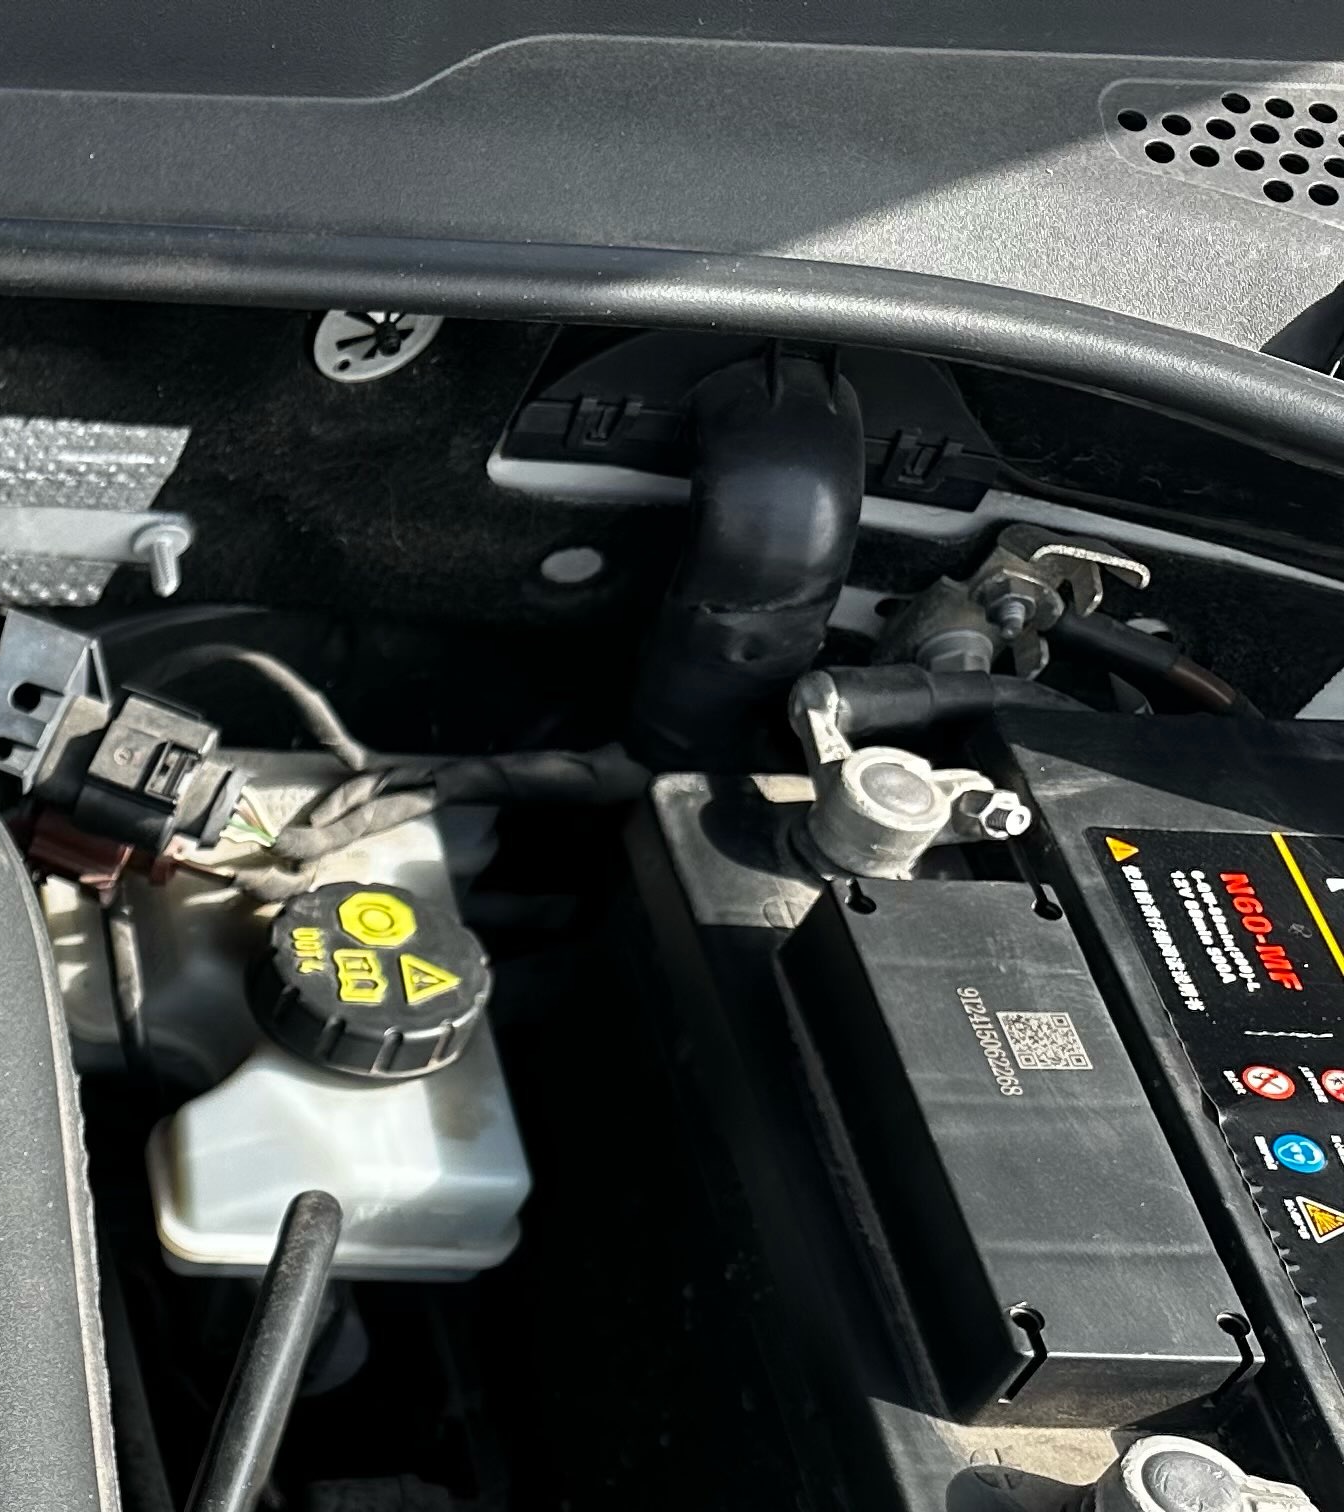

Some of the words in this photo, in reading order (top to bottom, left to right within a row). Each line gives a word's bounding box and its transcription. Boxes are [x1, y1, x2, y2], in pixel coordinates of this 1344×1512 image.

[1170, 870, 1195, 899] 12V
[292, 927, 324, 960] DOT
[1220, 873, 1303, 991] N60-MF
